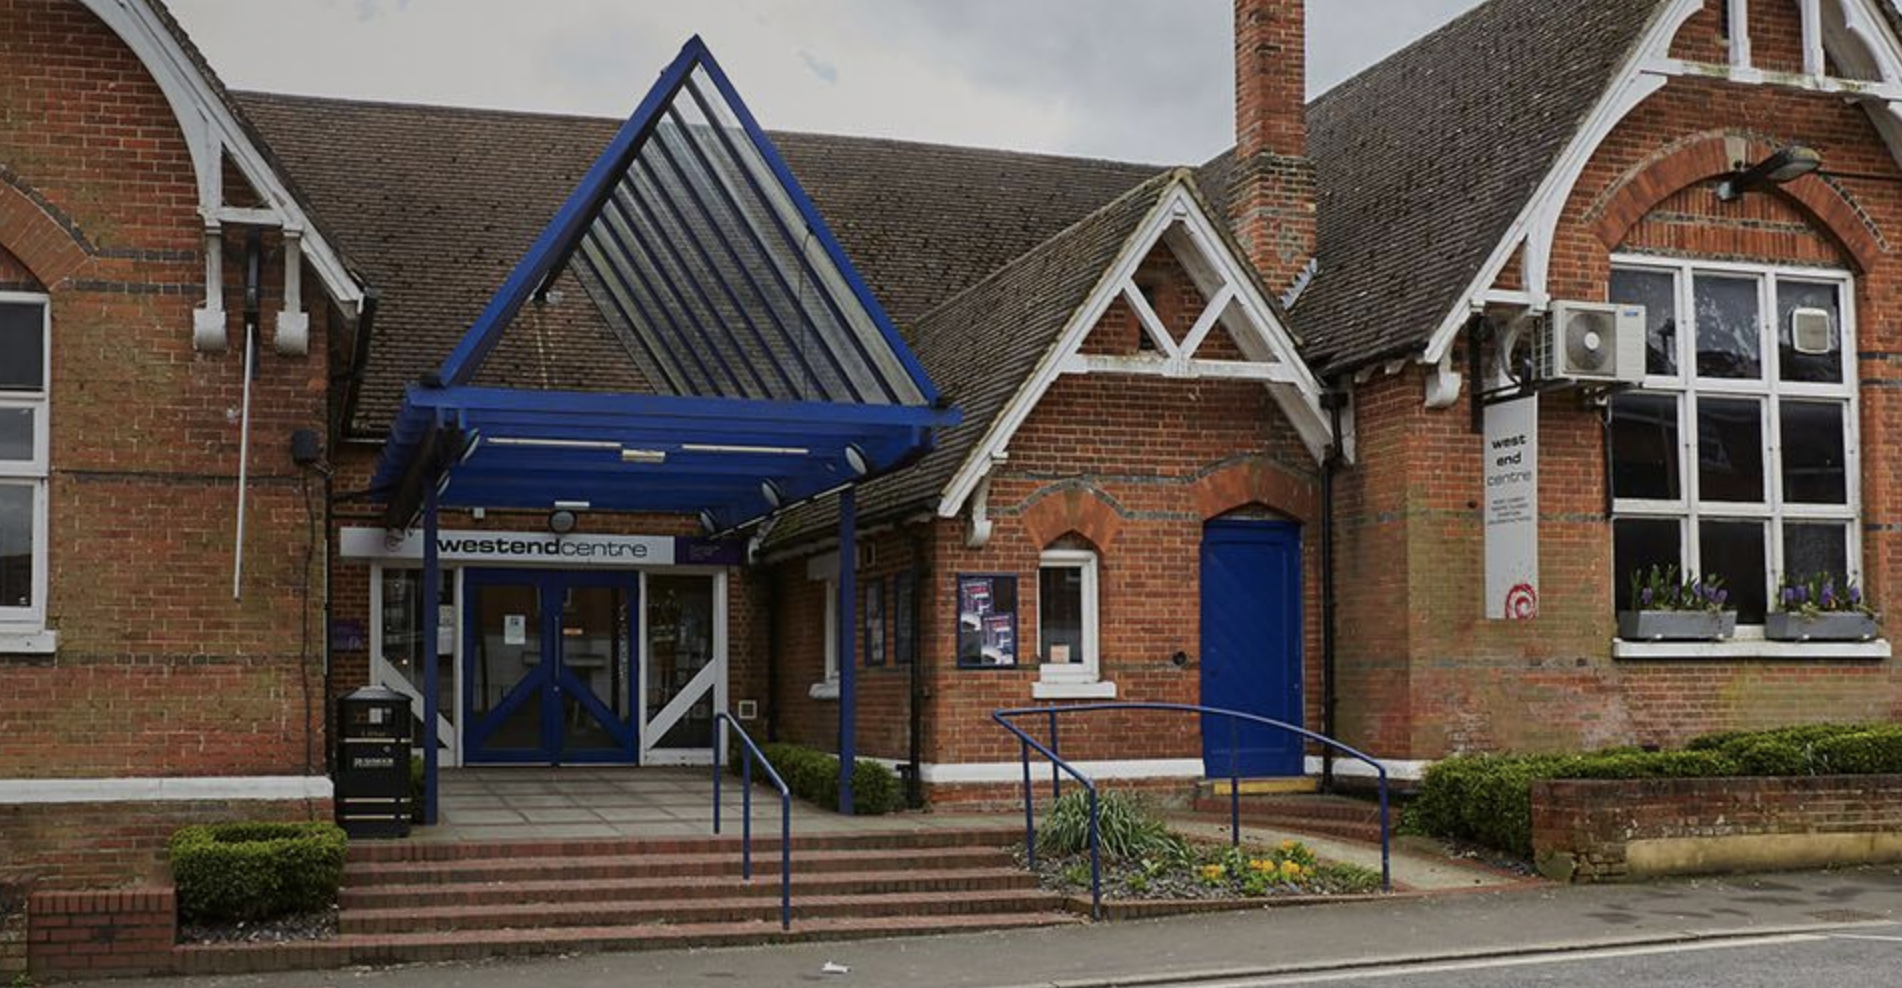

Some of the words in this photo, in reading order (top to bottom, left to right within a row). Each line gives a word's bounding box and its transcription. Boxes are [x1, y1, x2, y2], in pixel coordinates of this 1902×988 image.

[1491, 434, 1526, 450] west
[1496, 450, 1522, 467] end
[1487, 471, 1532, 487] centre
